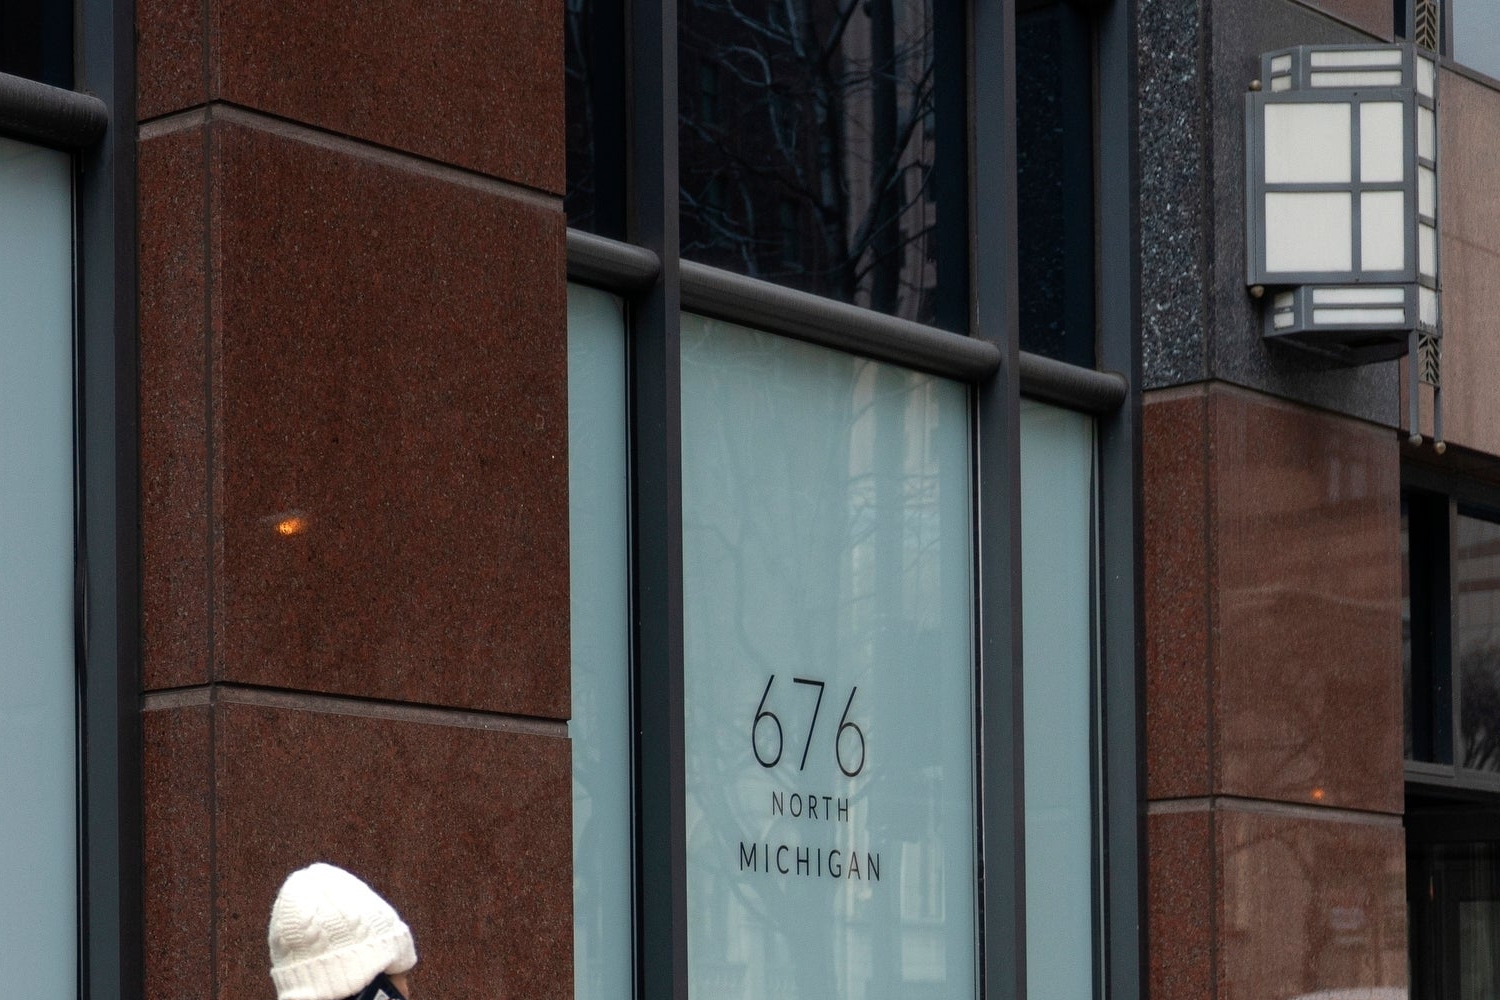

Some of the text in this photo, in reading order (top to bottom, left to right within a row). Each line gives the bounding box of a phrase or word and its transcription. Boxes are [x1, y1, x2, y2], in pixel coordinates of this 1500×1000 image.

[752, 674, 865, 777] 676
[772, 791, 849, 822] NORTH
[739, 842, 880, 881] MICHIGAN
